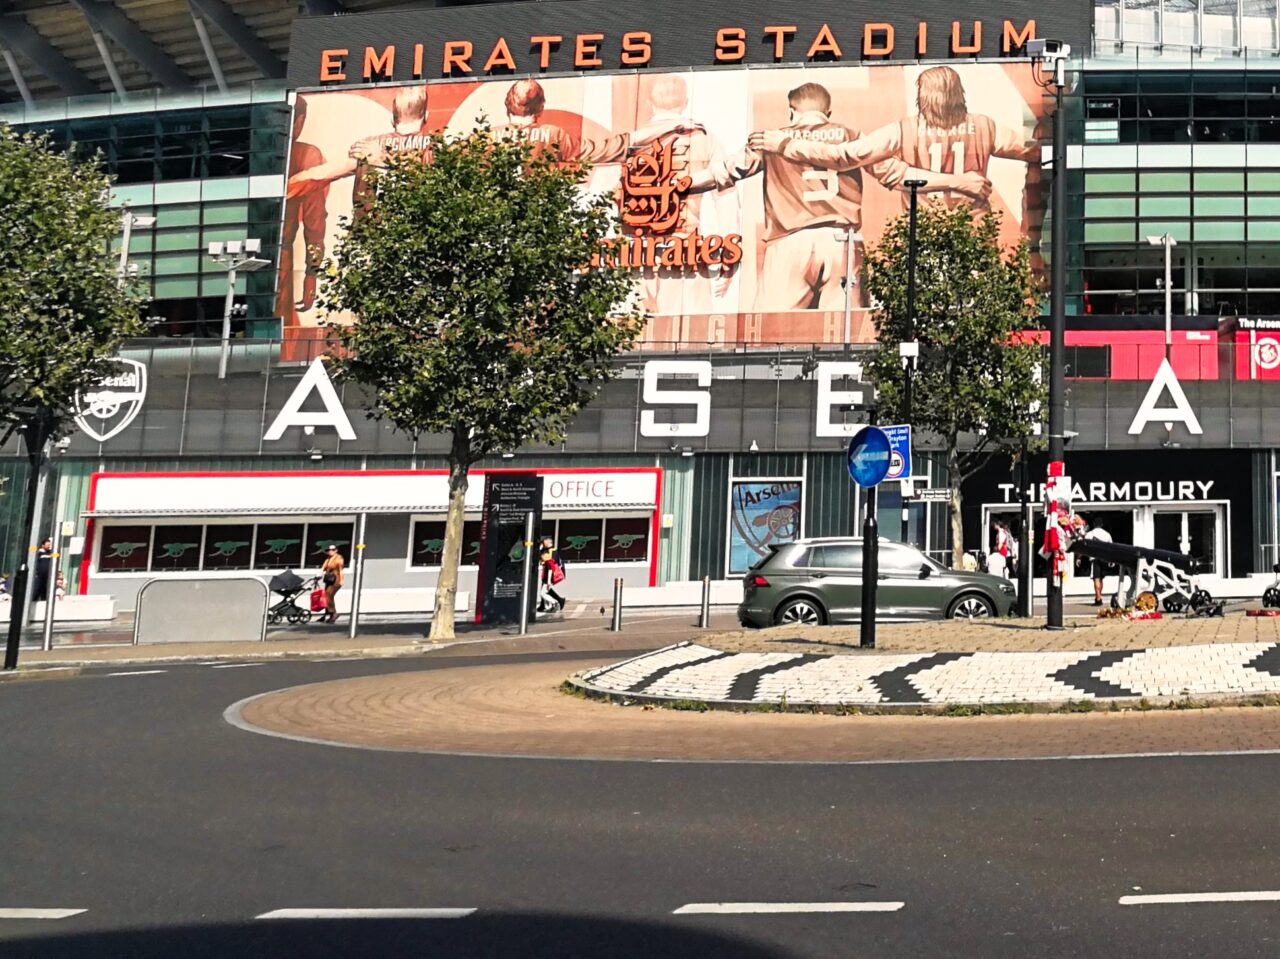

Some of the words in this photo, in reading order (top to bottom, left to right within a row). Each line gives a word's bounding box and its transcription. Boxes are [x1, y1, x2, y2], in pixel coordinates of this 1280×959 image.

[319, 31, 652, 82] EMIRATES
[715, 19, 1036, 61] STADIUM
[591, 228, 743, 268] mirates
[1239, 318, 1255, 329] The
[98, 372, 136, 387] senal
[550, 480, 615, 498] OFFICE
[1071, 480, 1215, 501] ARMOURY
